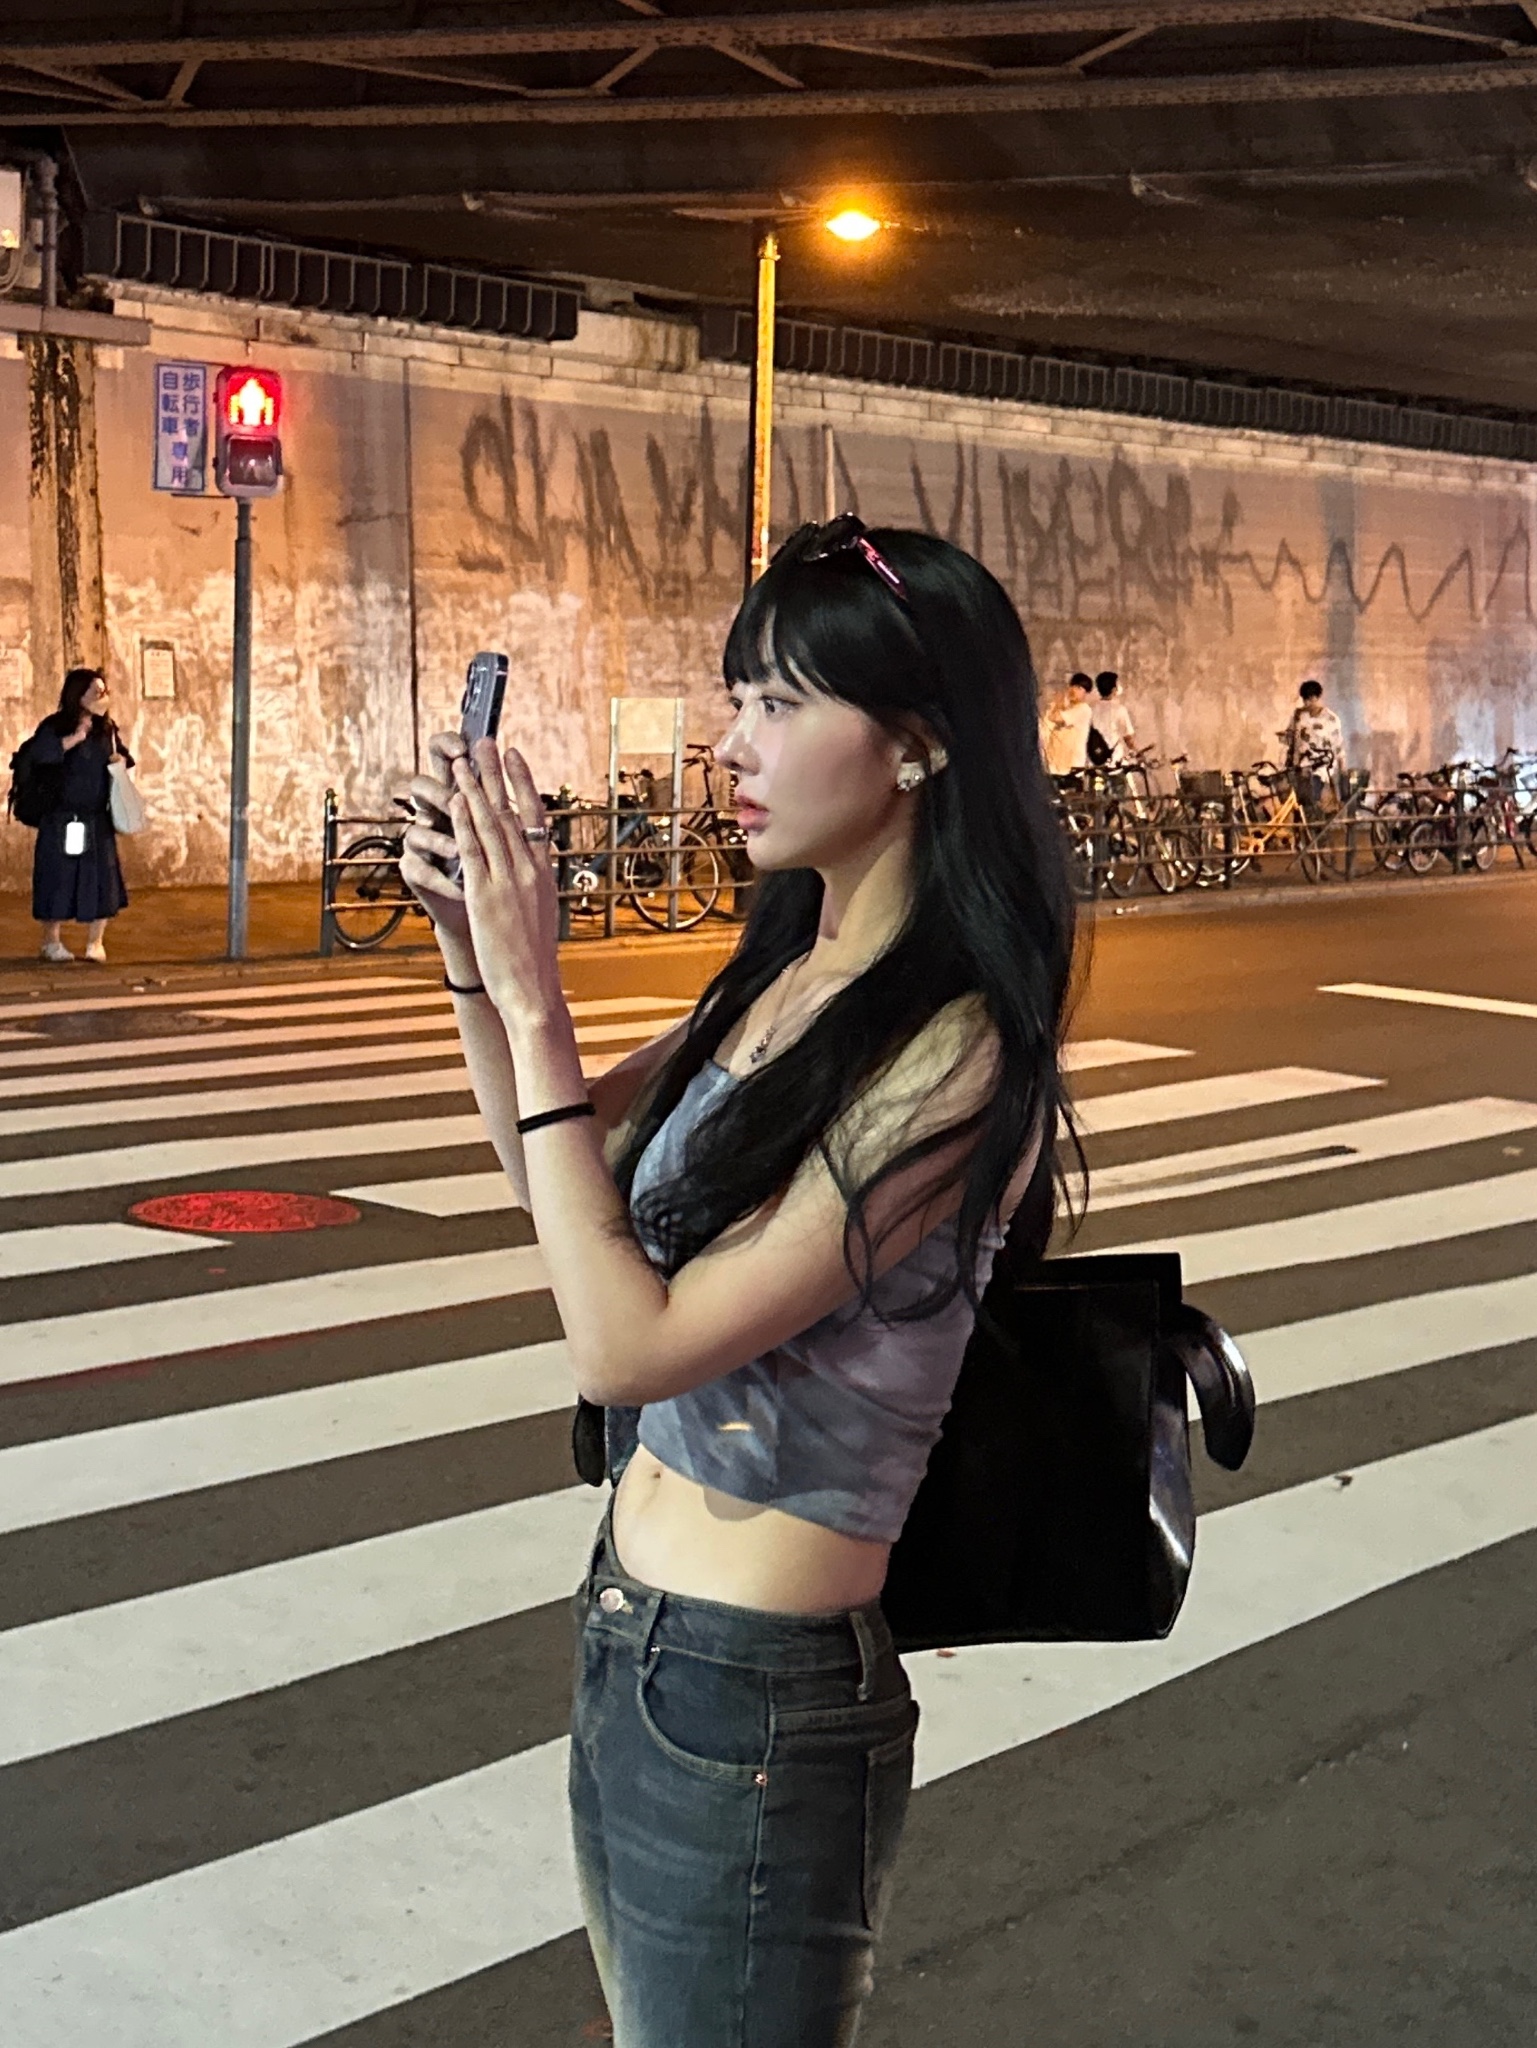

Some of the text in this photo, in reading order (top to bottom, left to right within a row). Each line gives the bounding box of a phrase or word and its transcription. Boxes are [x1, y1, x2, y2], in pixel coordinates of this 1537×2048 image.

[162, 371, 179, 435] 自転車
[183, 372, 201, 437] 歩行者
[171, 441, 188, 487] 用
